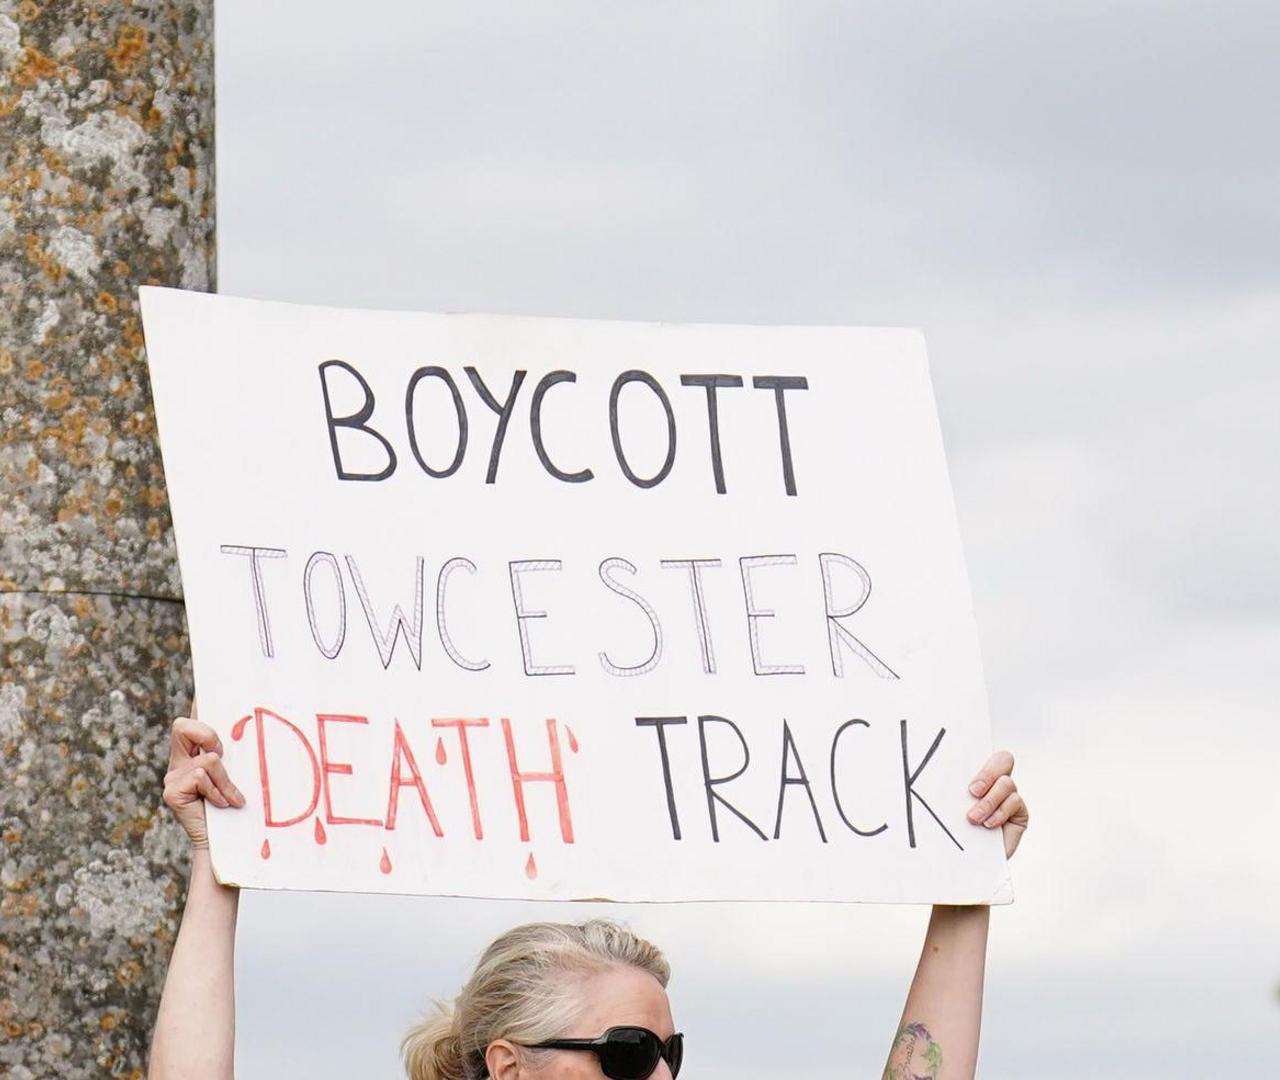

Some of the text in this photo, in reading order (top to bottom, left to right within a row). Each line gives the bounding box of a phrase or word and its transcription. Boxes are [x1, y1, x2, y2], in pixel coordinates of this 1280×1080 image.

[319, 360, 808, 496] BOYCOTT
[220, 545, 900, 679] TOWCESTER
[635, 715, 964, 851] TRACK
